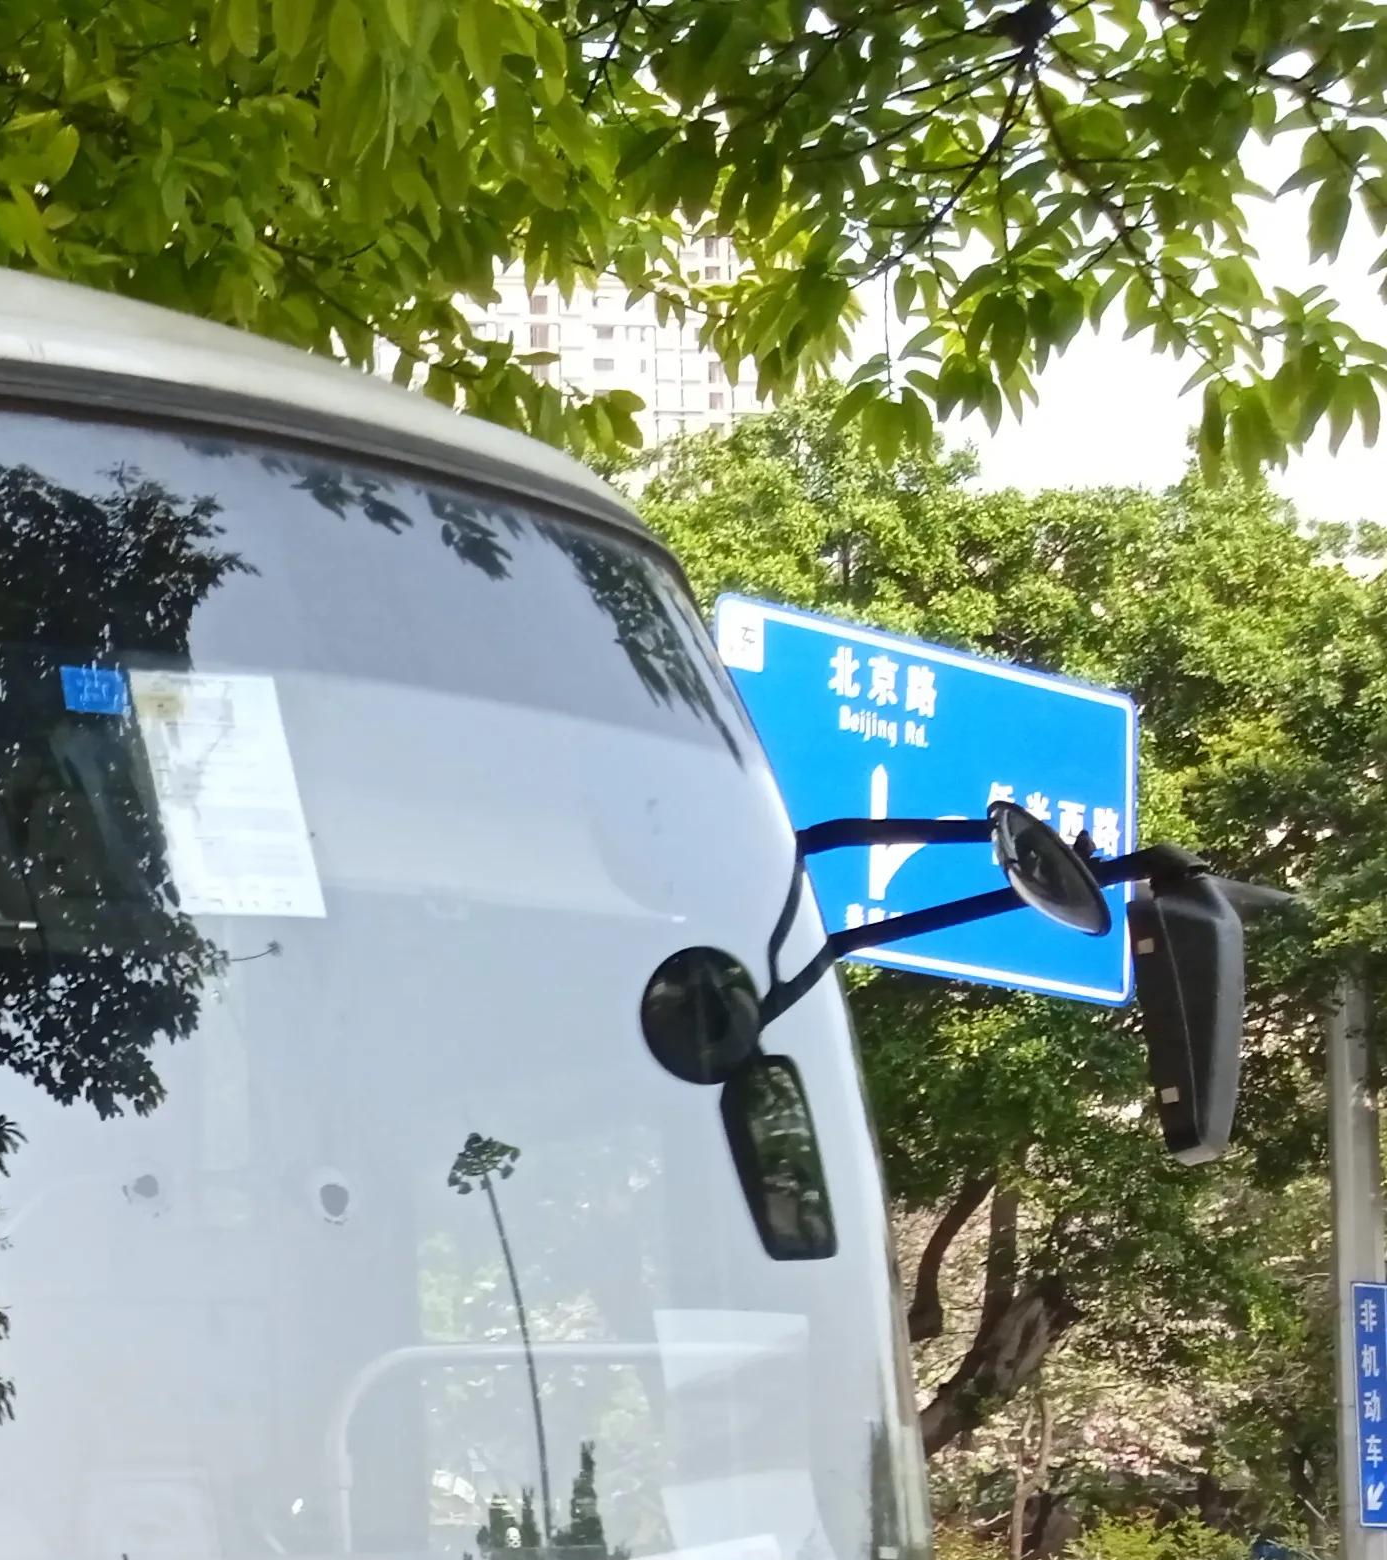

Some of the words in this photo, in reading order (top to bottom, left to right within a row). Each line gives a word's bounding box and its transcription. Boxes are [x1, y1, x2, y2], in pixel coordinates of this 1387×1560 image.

[829, 646, 937, 718] 北京路
[839, 705, 897, 748] Beijing
[904, 721, 929, 749] Rd.
[1359, 1298, 1384, 1469] 非机动车
